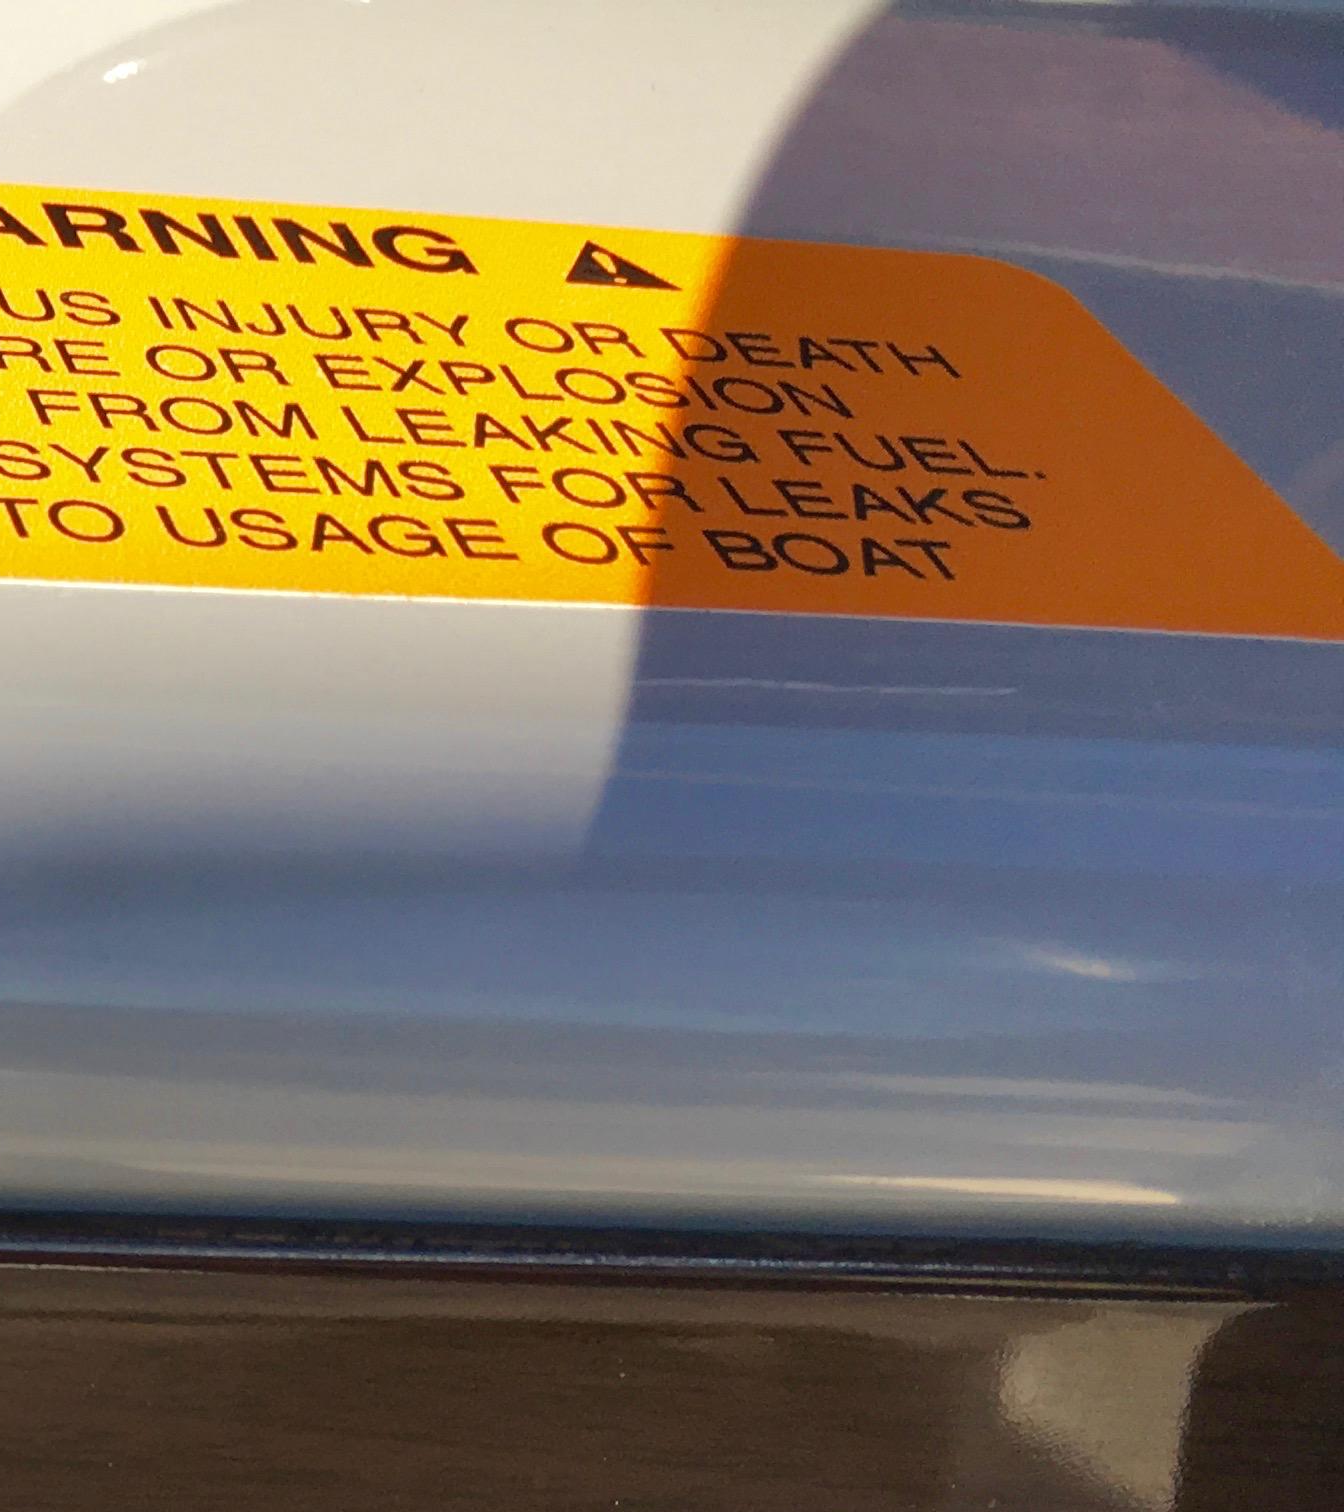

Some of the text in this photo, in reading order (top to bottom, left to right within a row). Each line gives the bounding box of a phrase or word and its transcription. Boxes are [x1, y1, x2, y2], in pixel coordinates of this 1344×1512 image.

[151, 297, 471, 348] INJURY
[504, 317, 646, 358] OR
[661, 327, 960, 378] DEATH
[147, 346, 290, 389] OR
[315, 355, 853, 419] EXPLOSION
[27, 390, 322, 441] FROM
[342, 406, 758, 463] LEAKING
[780, 430, 1047, 480] FUEL.
[490, 465, 704, 513] FOR
[717, 478, 1033, 531] LEAKS
[164, 507, 519, 560] USAGE
[541, 523, 674, 565] OF
[703, 530, 957, 580] BOAT
